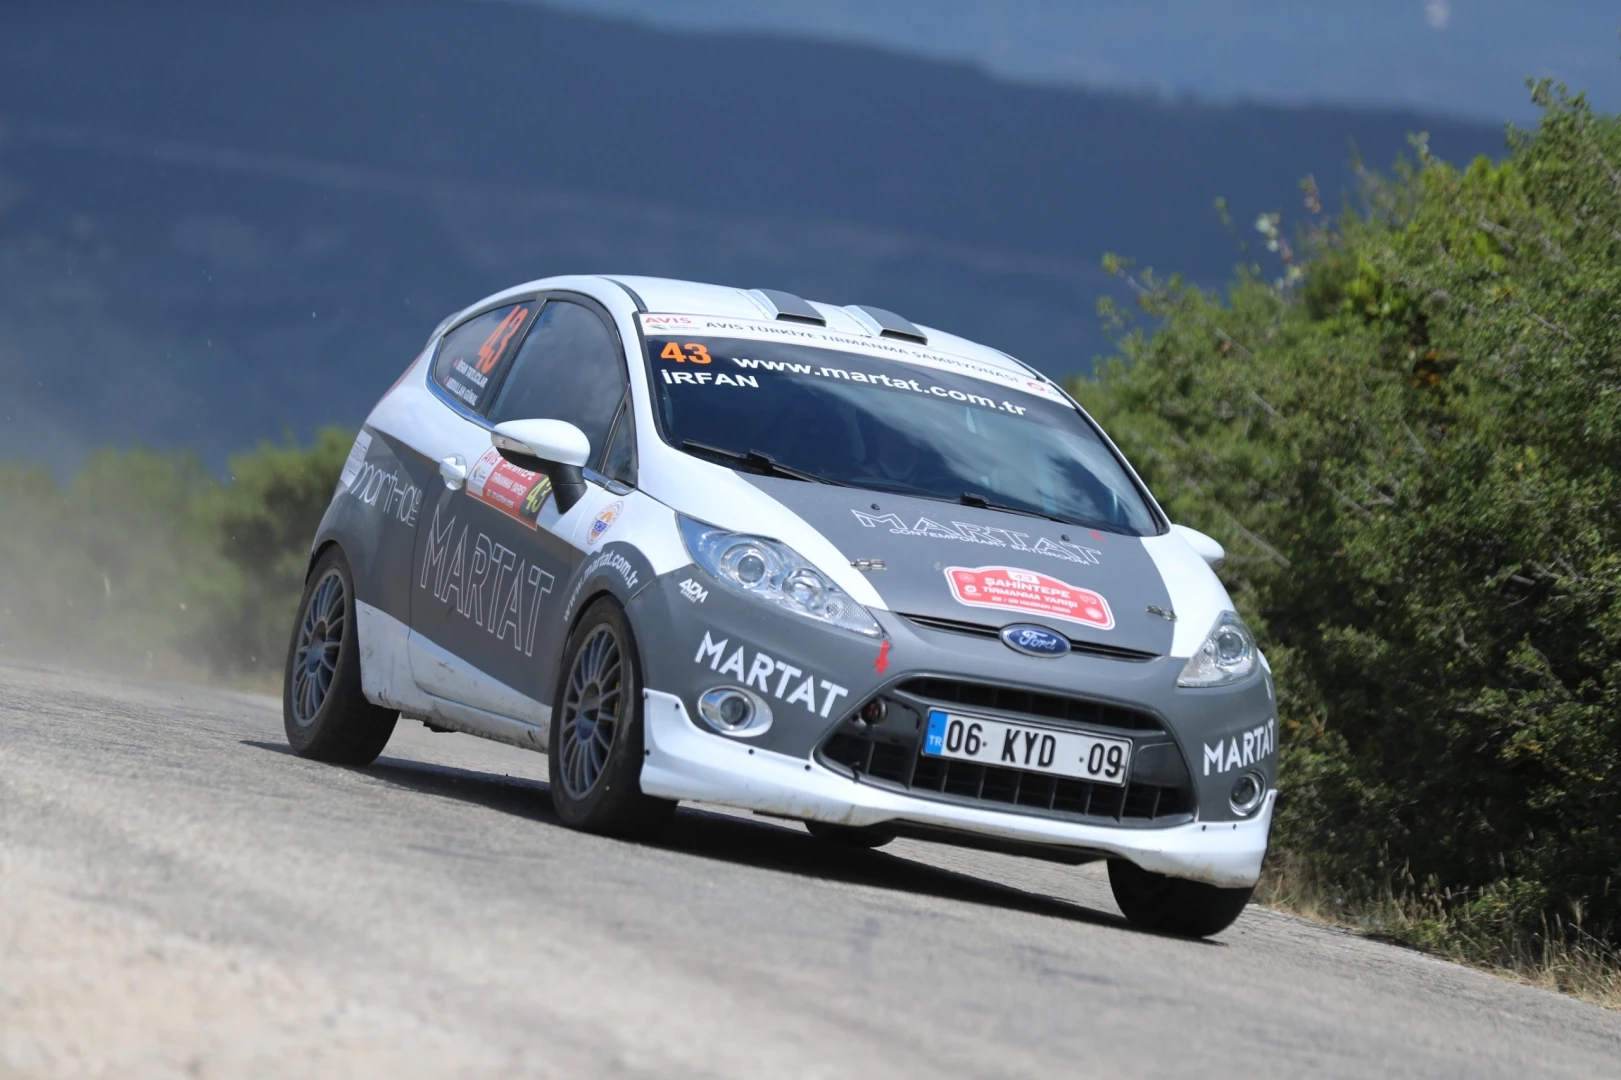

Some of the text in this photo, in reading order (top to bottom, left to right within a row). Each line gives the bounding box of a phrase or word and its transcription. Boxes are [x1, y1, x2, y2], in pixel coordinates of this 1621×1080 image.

[475, 305, 528, 374] 43
[660, 341, 712, 365] 43
[706, 322, 743, 330] AVIS
[746, 325, 816, 339] TÜRKİYE
[820, 335, 908, 355] TIRMANMA
[660, 369, 759, 388] İRFAN
[732, 357, 1027, 416] www.martat.com.tr
[482, 450, 501, 466] AVIS
[526, 476, 552, 513] 43
[851, 509, 1102, 564] MARTAT
[889, 528, 1091, 565] CONTEMPORARY BATHROOM
[420, 504, 555, 657] MARTAT
[984, 577, 1071, 599] ŞAHİNTEPE
[1019, 630, 1057, 650] Ford
[694, 630, 849, 718] MARTAT
[929, 735, 943, 747] TR
[946, 720, 1124, 778] 06 KYD 09
[1203, 718, 1274, 776] MARTAT
